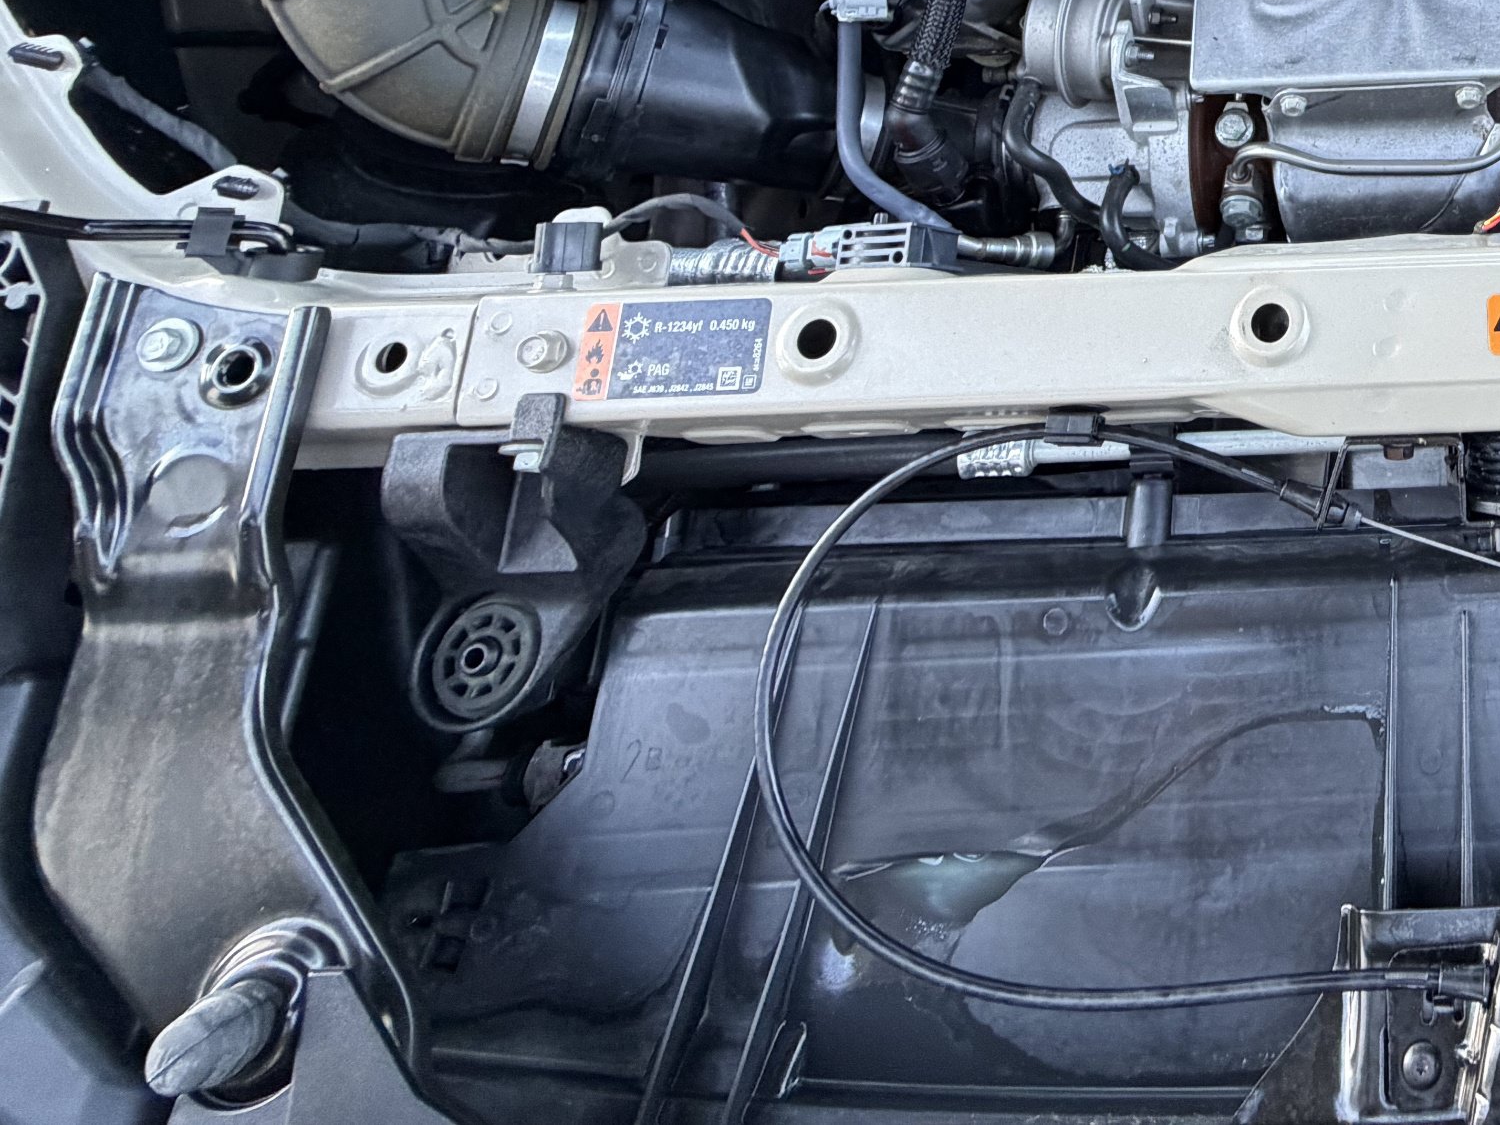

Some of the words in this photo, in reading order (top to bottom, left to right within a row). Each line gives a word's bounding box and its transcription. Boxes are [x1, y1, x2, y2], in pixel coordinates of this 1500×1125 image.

[654, 320, 703, 334] R-1234yf
[710, 319, 738, 331] 0.450
[741, 318, 756, 332] kg
[647, 363, 670, 376] PAG
